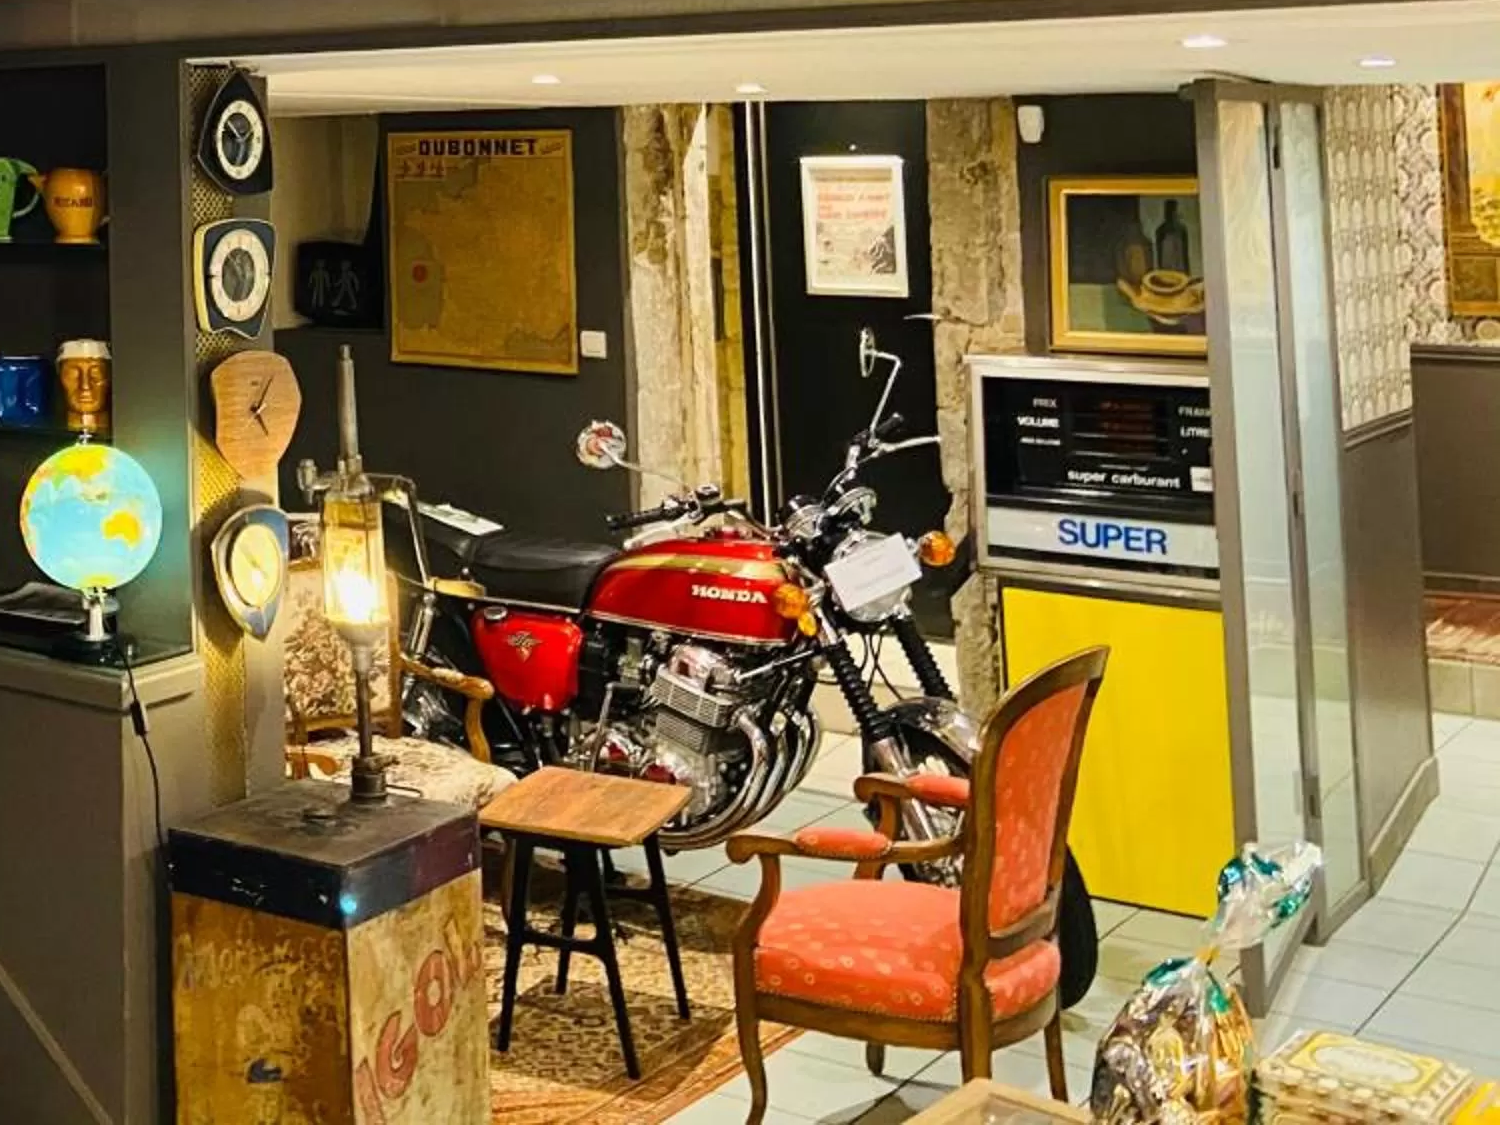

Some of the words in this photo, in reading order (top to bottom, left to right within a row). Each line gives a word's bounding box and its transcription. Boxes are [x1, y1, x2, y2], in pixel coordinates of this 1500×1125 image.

[418, 138, 537, 156] DUBONNET
[1067, 471, 1107, 484] super
[1111, 471, 1181, 489] carburant
[1057, 518, 1168, 556] SUPER
[692, 584, 769, 605] HONDA
